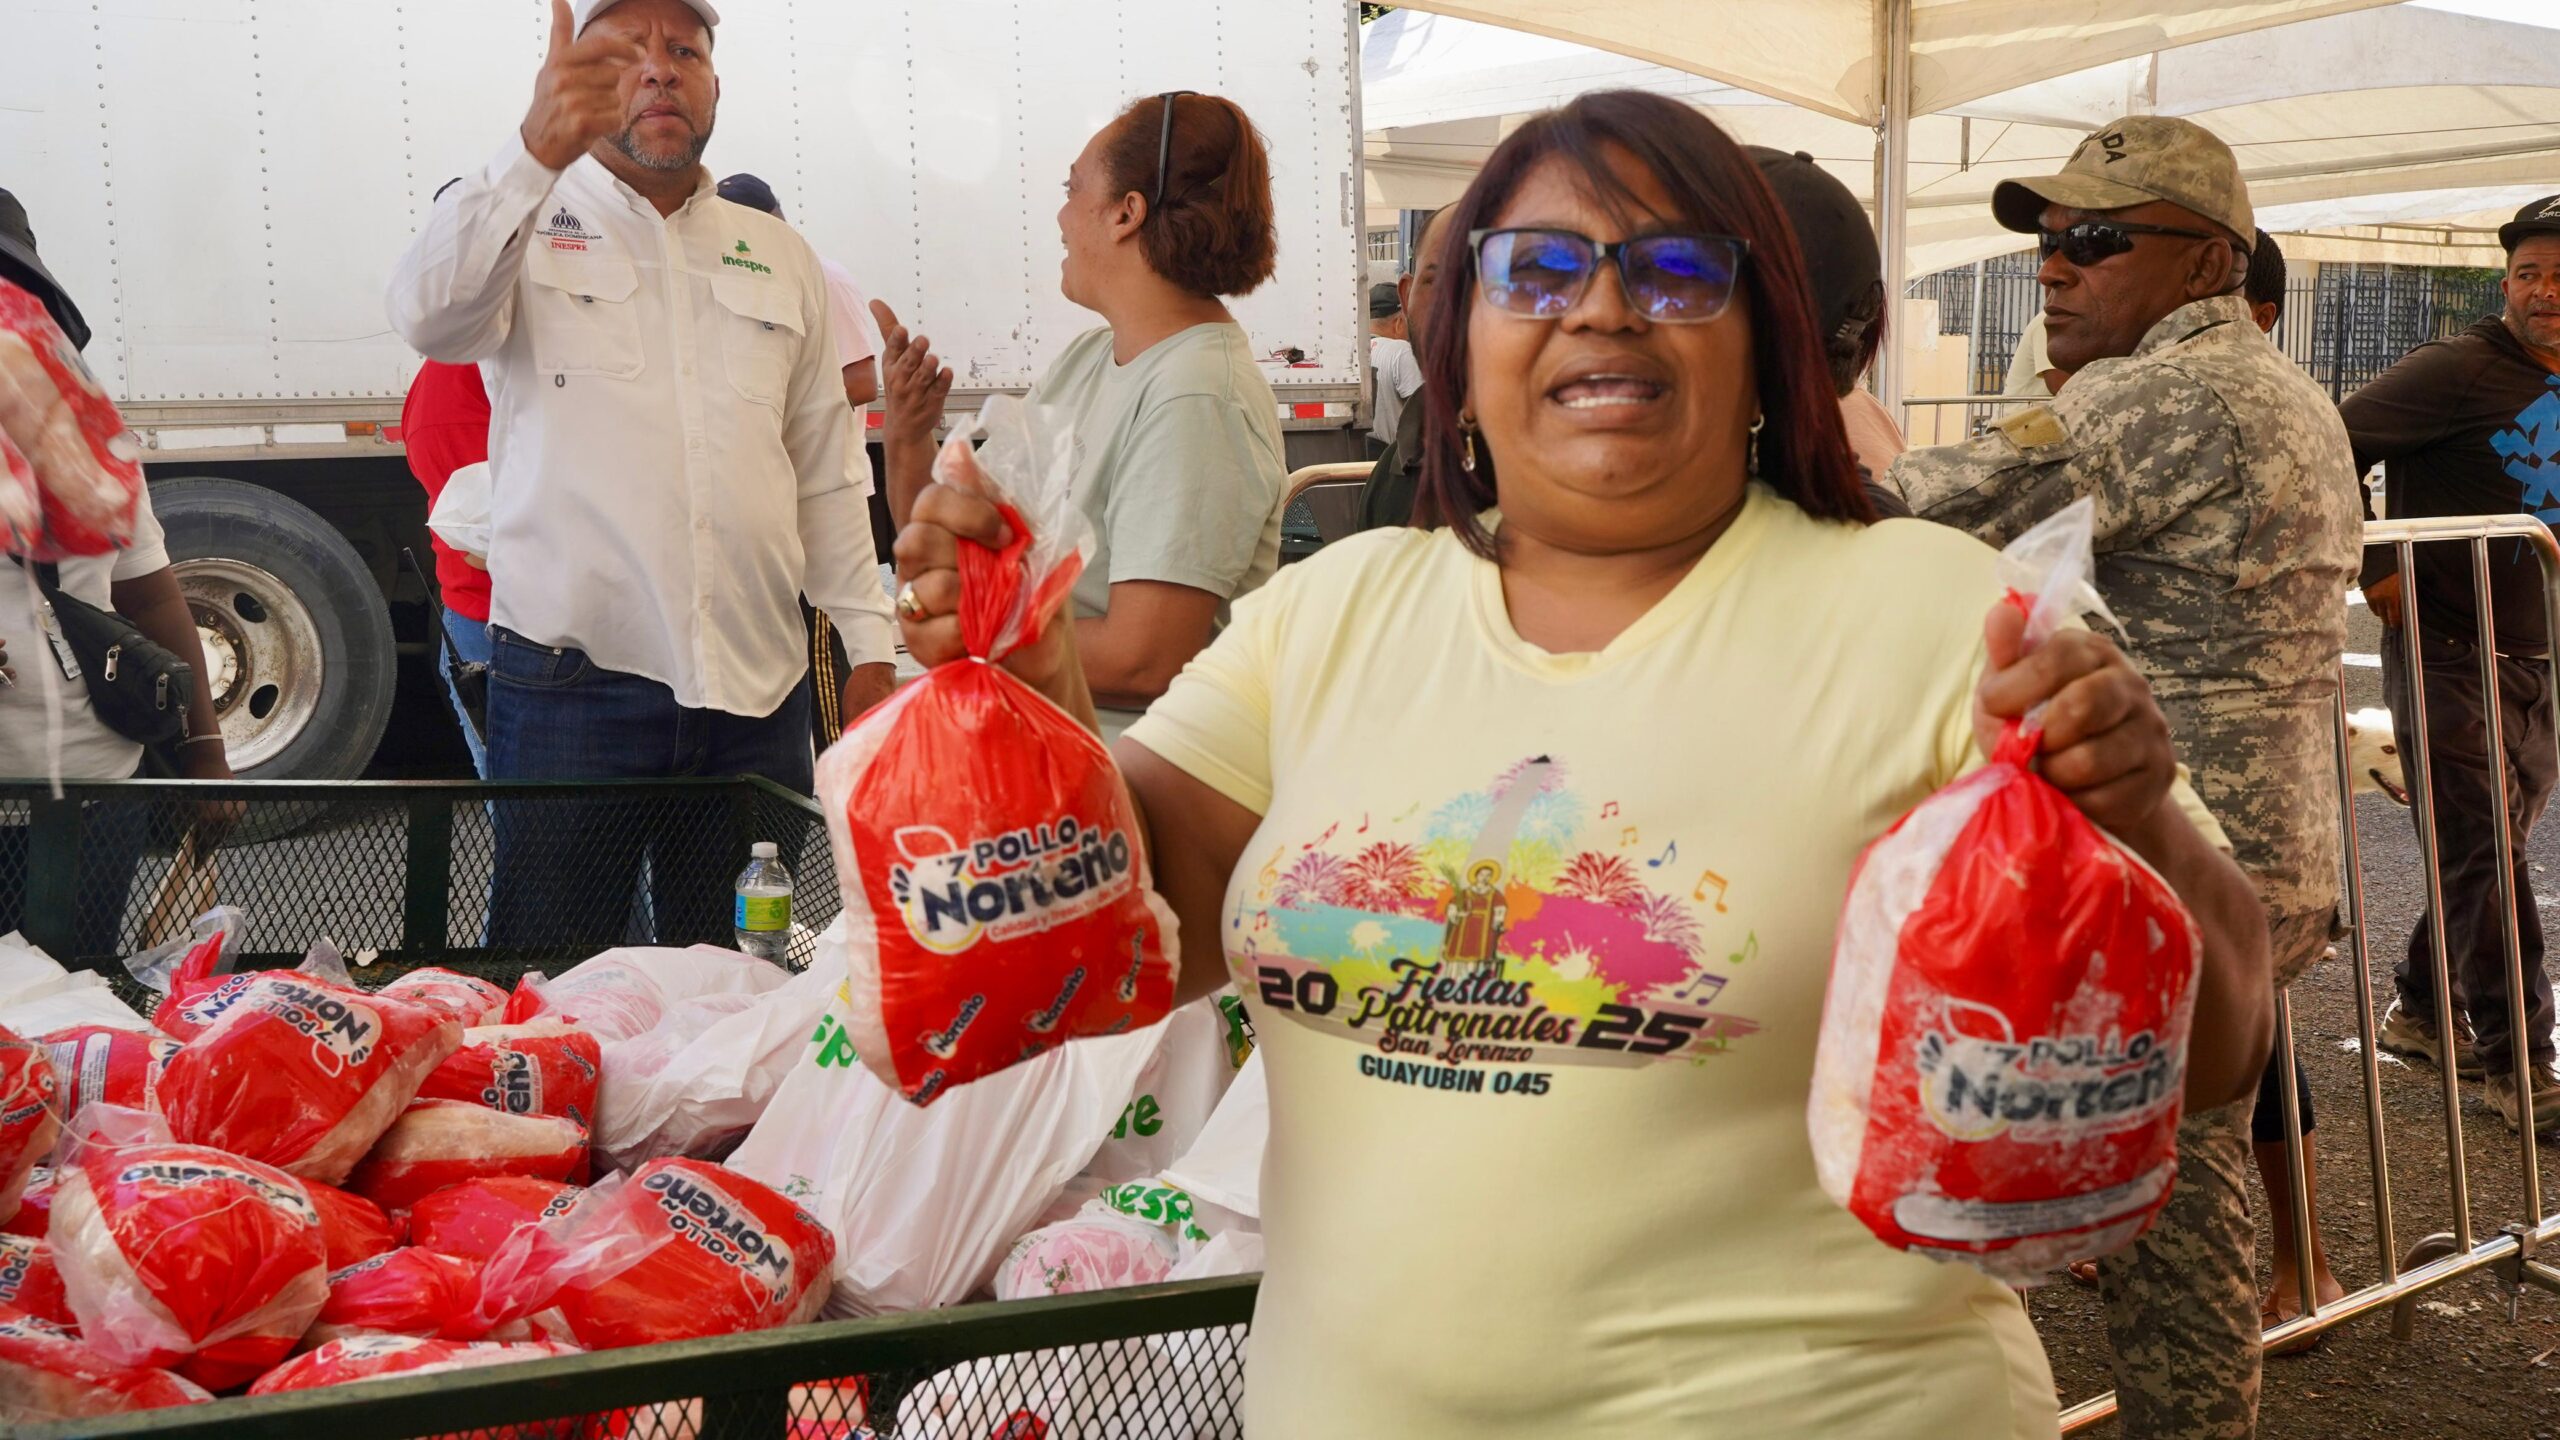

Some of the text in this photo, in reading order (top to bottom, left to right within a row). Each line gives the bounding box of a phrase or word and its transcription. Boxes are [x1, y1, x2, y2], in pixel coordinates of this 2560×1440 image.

[551, 241, 588, 251] INESPRE
[721, 252, 772, 275] inespre
[974, 818, 1079, 869] POLLO
[920, 829, 1130, 932] Norteño
[1036, 966, 1086, 1030] Norteño
[1258, 965, 1339, 1015] 20
[1389, 957, 1534, 1008] Fiestas
[935, 994, 985, 1052] Norteño
[1347, 986, 1578, 1044] Patronales
[1576, 1003, 1709, 1054] 25
[1377, 1027, 1534, 1066] San Lorenzo
[2030, 1032, 2154, 1067] POLLO
[1359, 1053, 1554, 1096] GUAYUBIN 045
[645, 1172, 790, 1280] Norteño
[670, 1214, 741, 1264] POLLO
